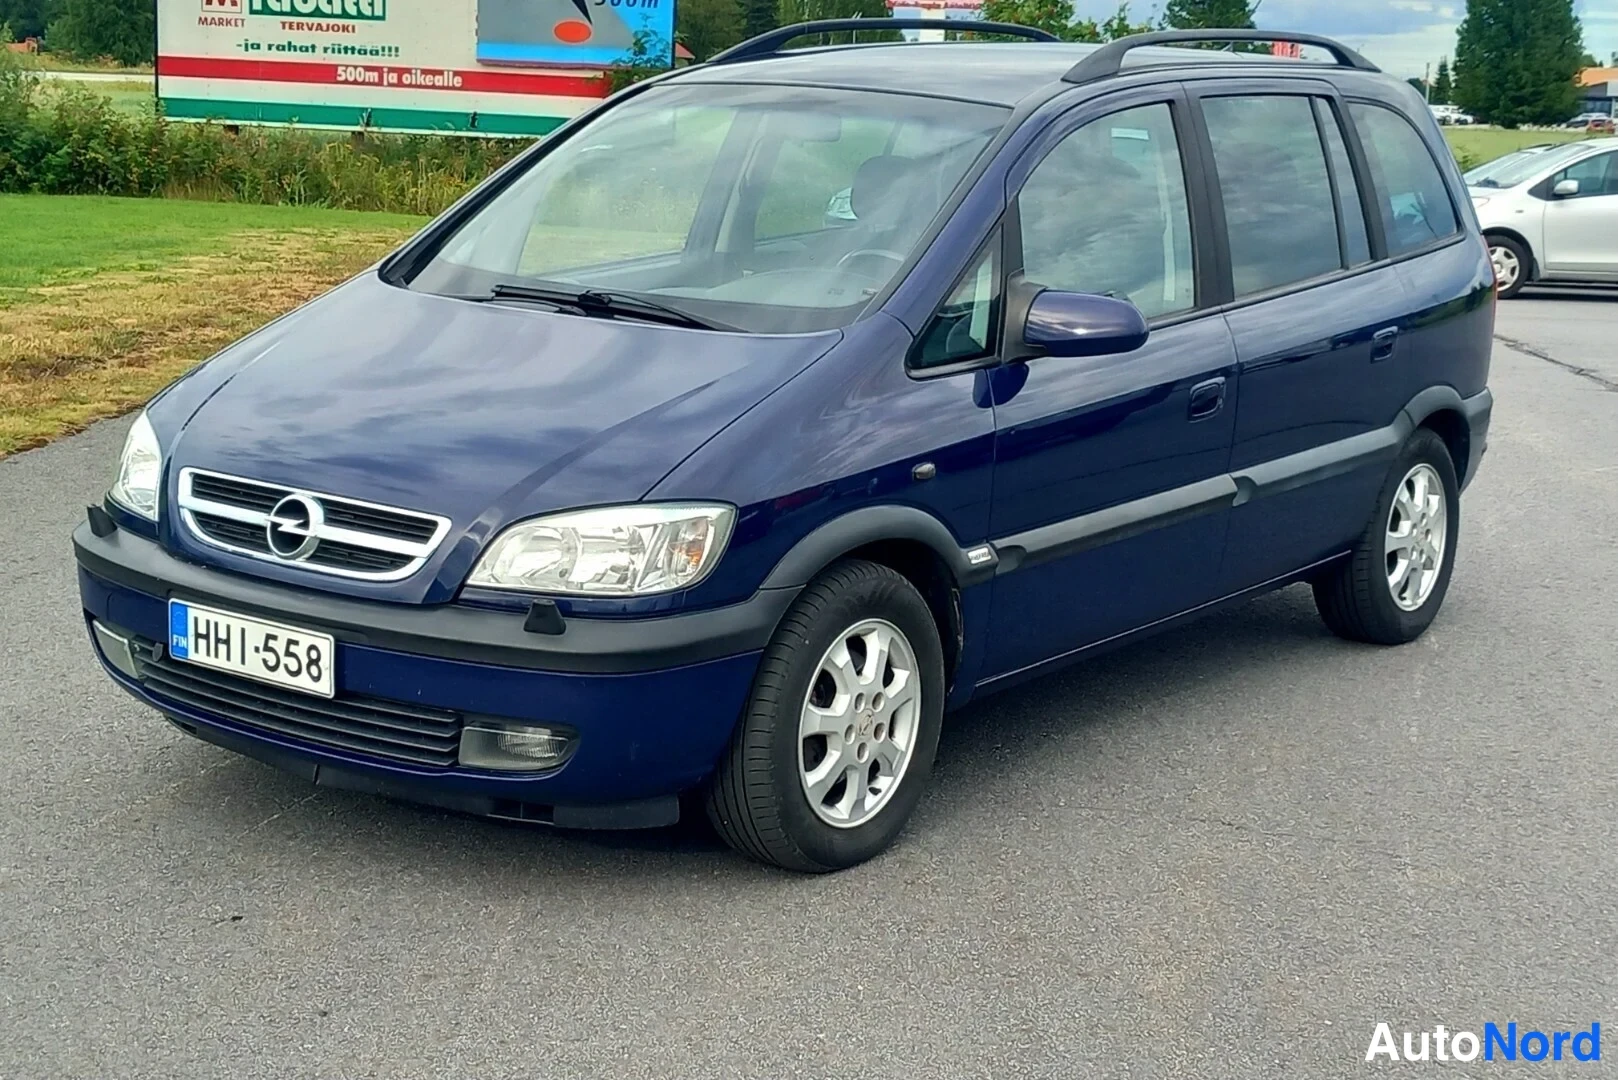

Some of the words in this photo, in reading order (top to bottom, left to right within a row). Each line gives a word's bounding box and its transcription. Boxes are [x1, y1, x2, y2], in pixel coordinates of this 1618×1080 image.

[198, 16, 246, 28] MARKET
[280, 21, 356, 33] TERVAJOKI
[236, 39, 261, 52] -ja
[267, 41, 317, 54] rahat
[323, 43, 400, 57] riittää!!!
[336, 66, 379, 83] 500m
[383, 69, 398, 86] ja
[402, 69, 462, 87] oikealle
[172, 634, 187, 649] FIN
[193, 616, 322, 683] HHI-558
